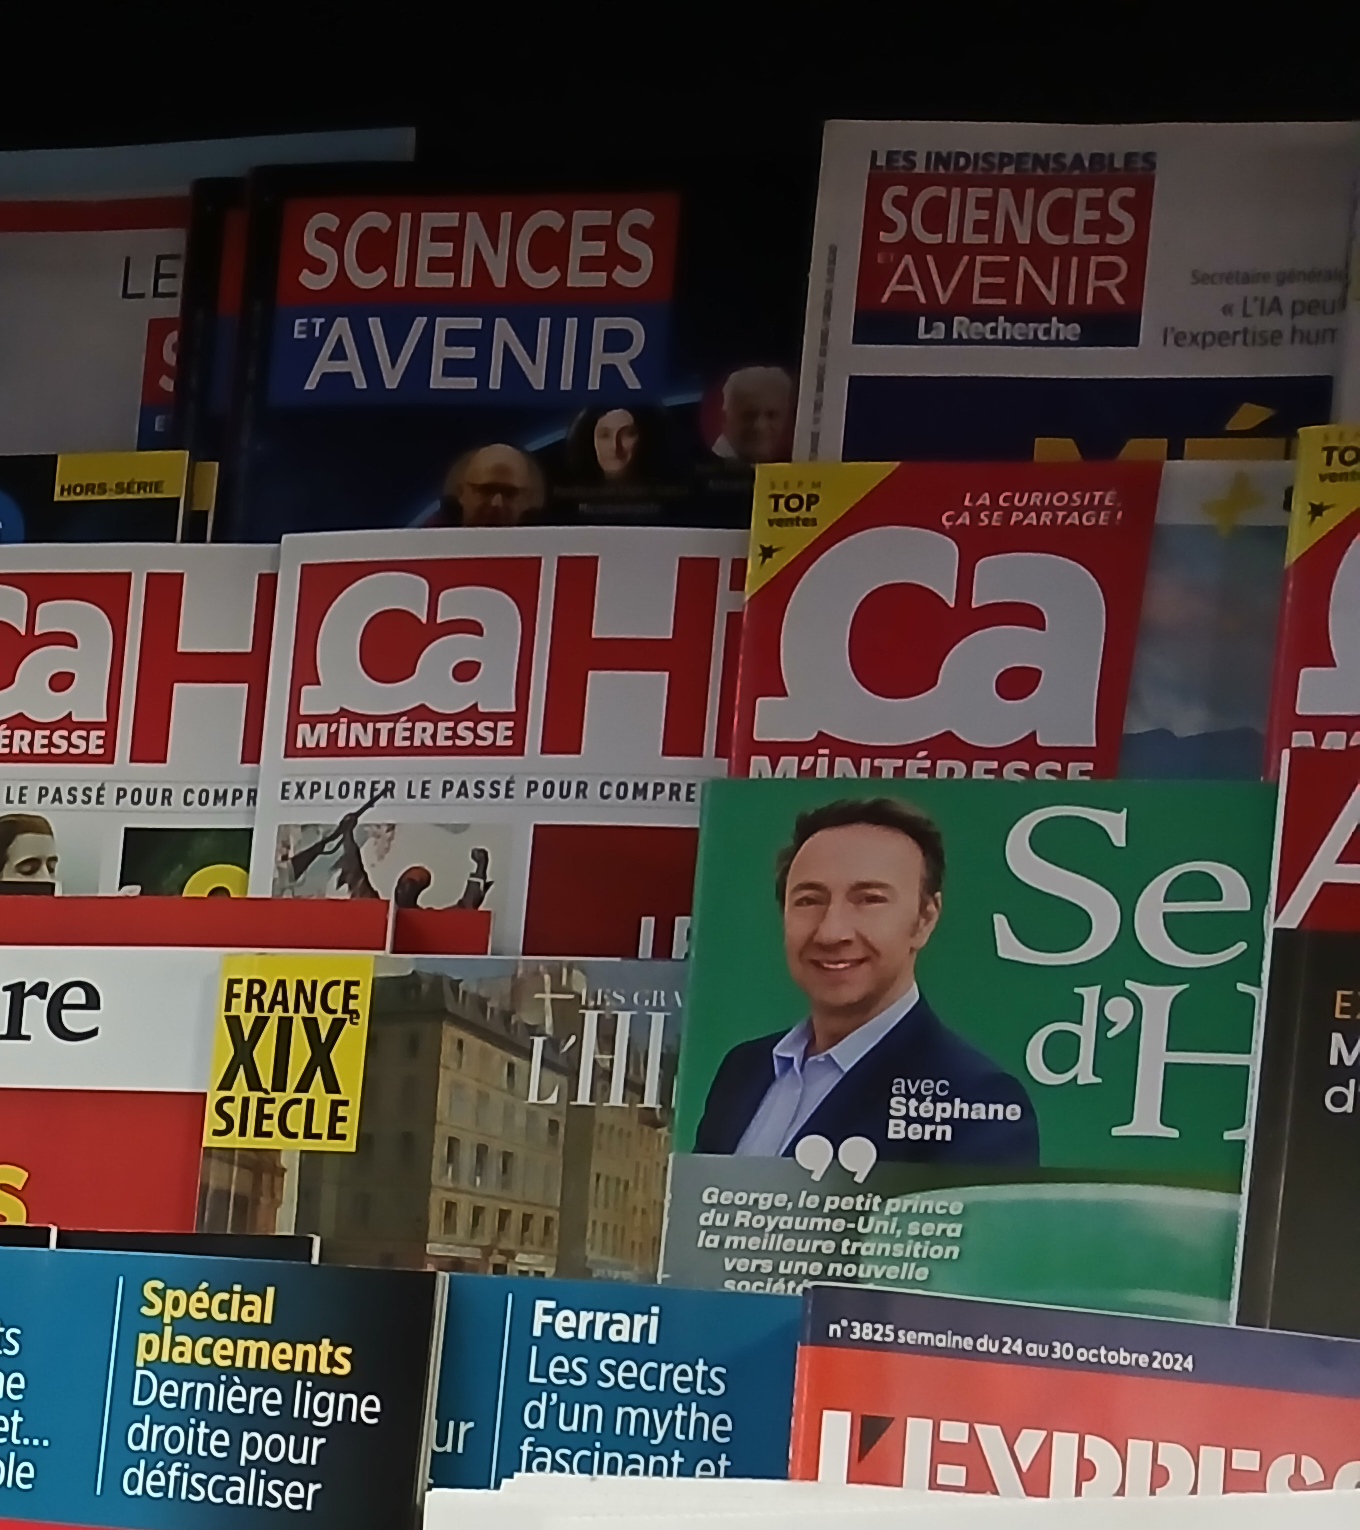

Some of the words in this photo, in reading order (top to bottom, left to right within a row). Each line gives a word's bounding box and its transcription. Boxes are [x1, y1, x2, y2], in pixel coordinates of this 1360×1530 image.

[870, 150, 917, 172] LES
[925, 151, 1156, 173] INDISPENSABLES
[880, 186, 1136, 244] SCIENCES
[299, 209, 655, 290] SCIENCES
[881, 254, 1129, 305] AVENIR
[918, 315, 946, 339] La
[953, 316, 1080, 341] Recherche
[304, 317, 646, 391] AVENIR
[768, 493, 820, 513] TOP
[964, 491, 991, 506] LA
[768, 515, 817, 527] ventes
[941, 510, 971, 529] ÇA
[977, 510, 1003, 526] SE
[1009, 510, 1109, 526] PARTAGE
[5, 784, 28, 805] LE
[36, 780, 106, 806] PASSÉ
[115, 784, 172, 807] POUR
[224, 978, 362, 1014] FRANCE
[892, 1077, 950, 1095] avec
[213, 1089, 349, 1140] SIÈCLE
[889, 1096, 1021, 1121] Stéphane
[888, 1120, 952, 1141] Bern
[823, 1193, 882, 1213] petit
[884, 1197, 964, 1215] prince
[907, 1221, 962, 1238] sera
[841, 1238, 960, 1260] transition
[827, 1260, 929, 1281] nouvelle
[140, 1280, 275, 1325] Spécial
[532, 1302, 660, 1344] Ferrari
[136, 1327, 352, 1375] placements
[850, 1322, 894, 1343] 3825
[898, 1329, 973, 1352] semaine
[1077, 1344, 1148, 1367] octobre
[1152, 1351, 1193, 1372] 2024
[123, 1459, 322, 1511] défiscaliser
